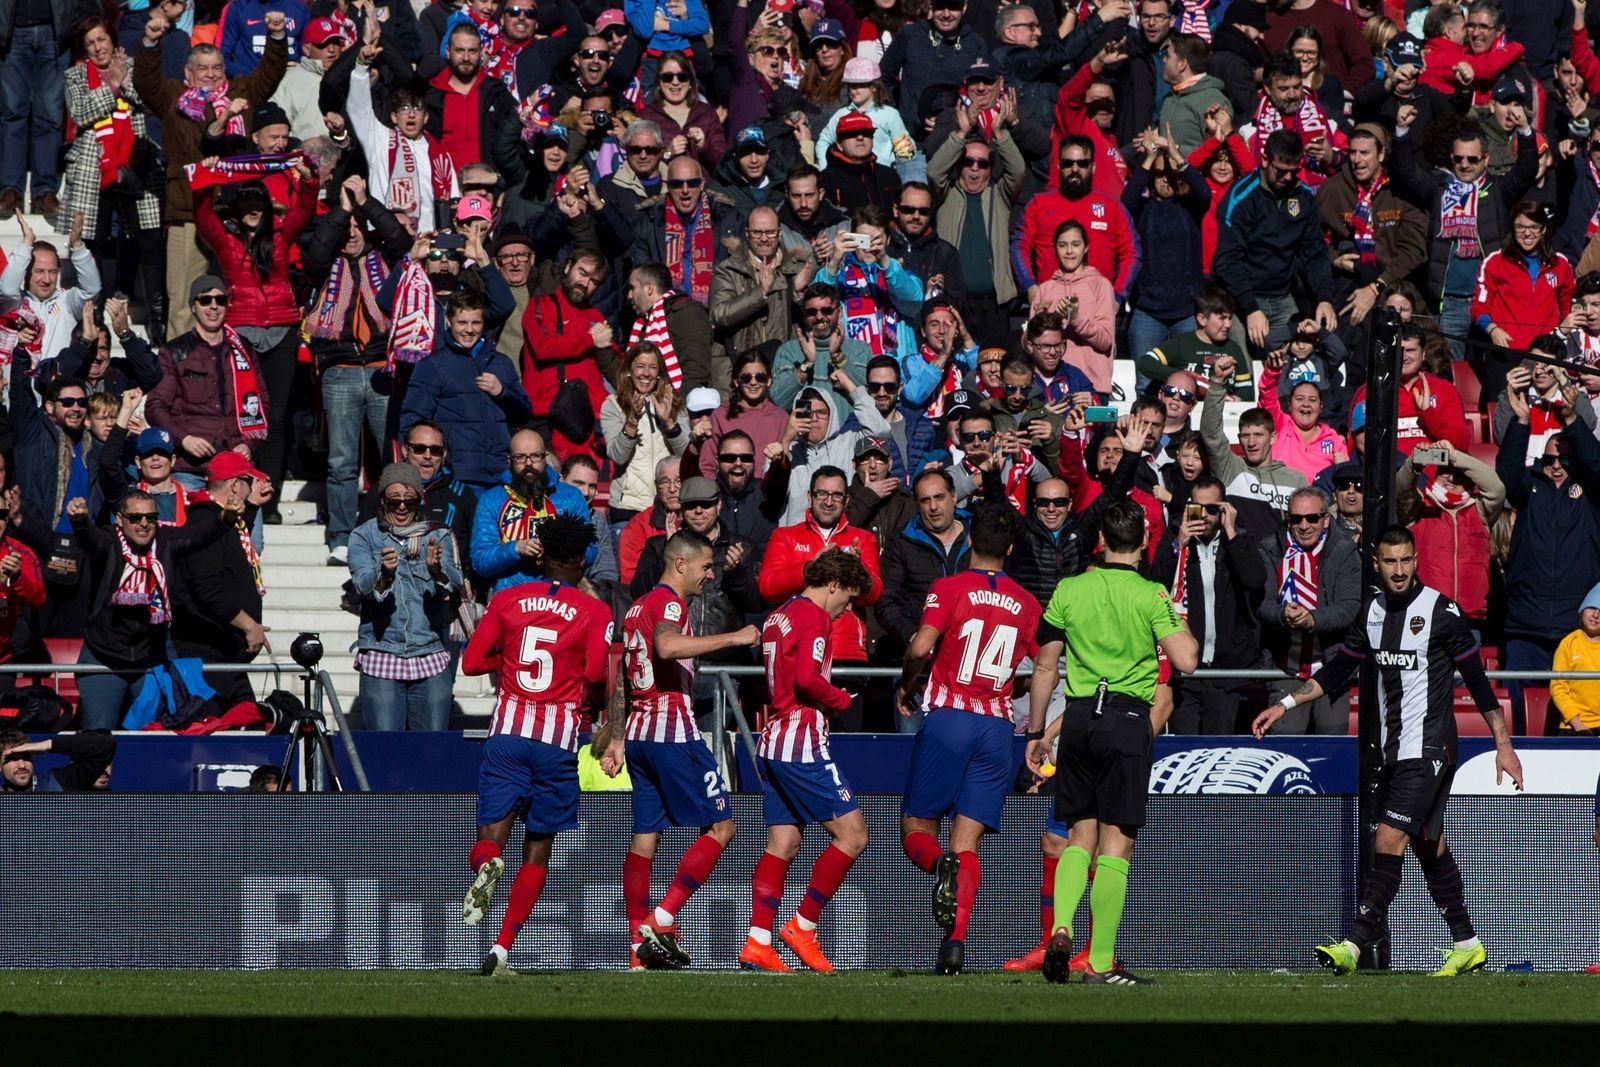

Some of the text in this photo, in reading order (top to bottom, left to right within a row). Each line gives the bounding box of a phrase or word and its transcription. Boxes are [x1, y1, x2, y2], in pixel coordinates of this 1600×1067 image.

[518, 596, 578, 622] THOMAS
[967, 589, 1022, 616] RODRIGO
[516, 625, 559, 693] 5
[762, 641, 777, 698] 7
[956, 617, 1019, 692] 14
[824, 762, 842, 787] 7
[1386, 809, 1412, 824] macron
[239, 876, 869, 969] Plus500
